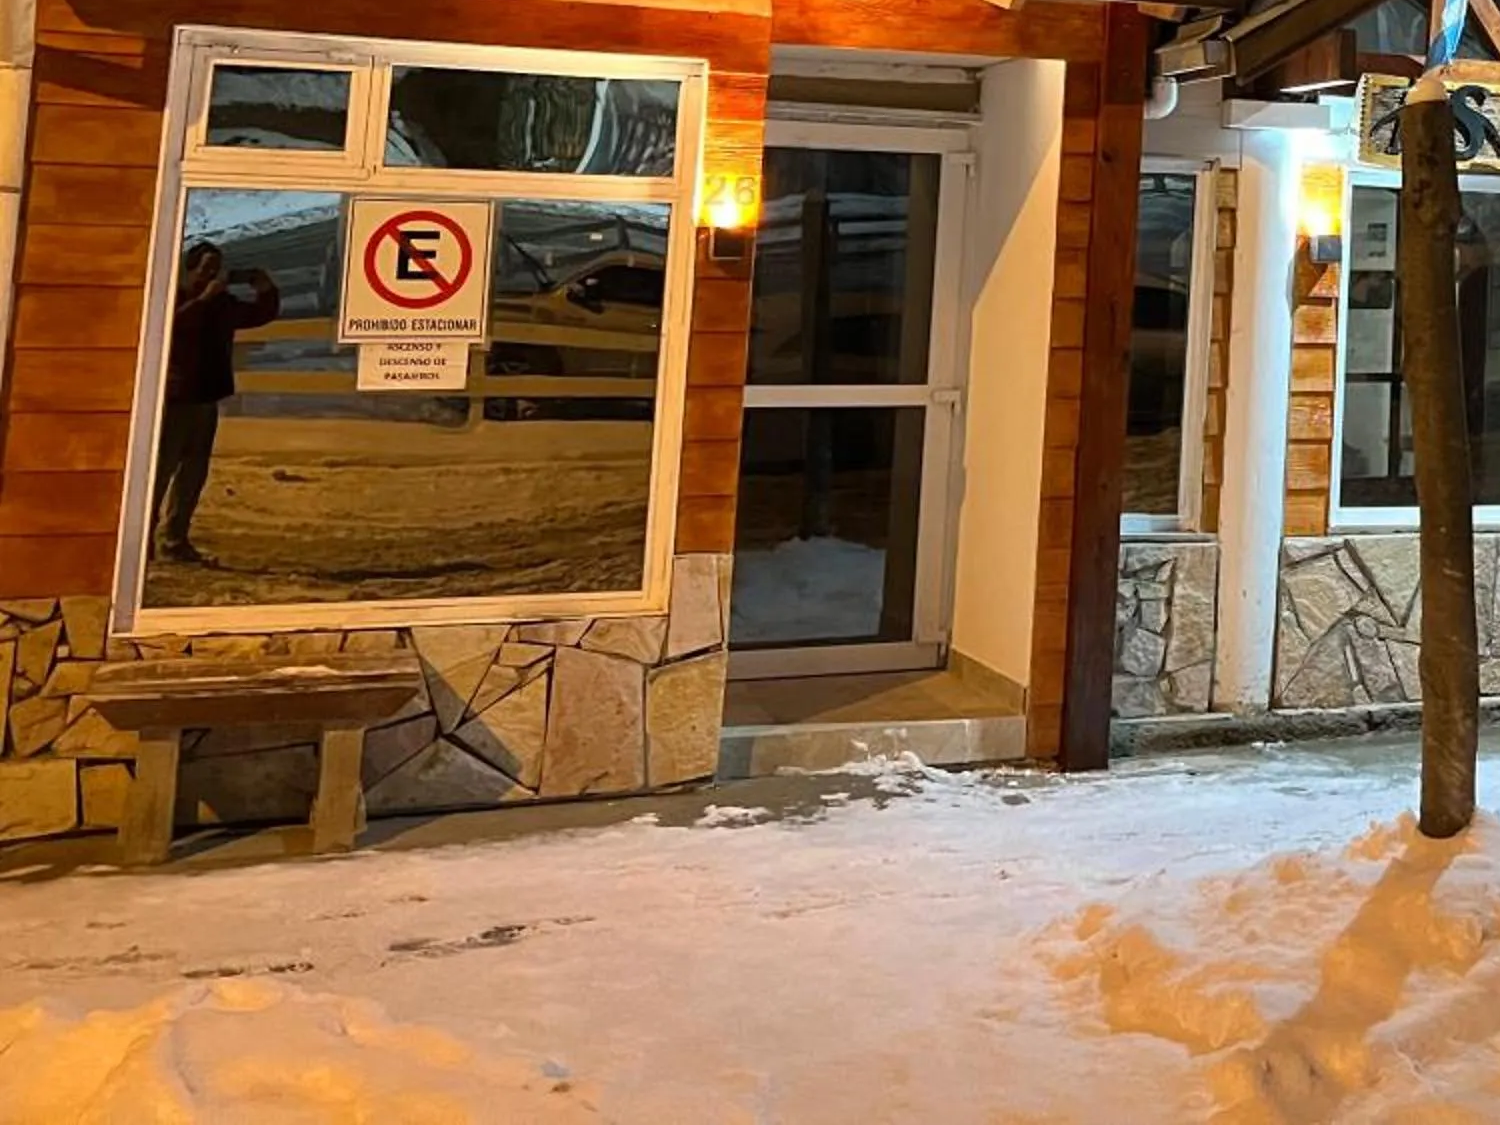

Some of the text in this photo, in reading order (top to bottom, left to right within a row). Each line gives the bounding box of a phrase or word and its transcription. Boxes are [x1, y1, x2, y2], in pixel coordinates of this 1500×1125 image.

[703, 176, 755, 205] 26
[396, 230, 441, 280] E
[349, 318, 477, 331] PROHIBIDO ESTACIONAR
